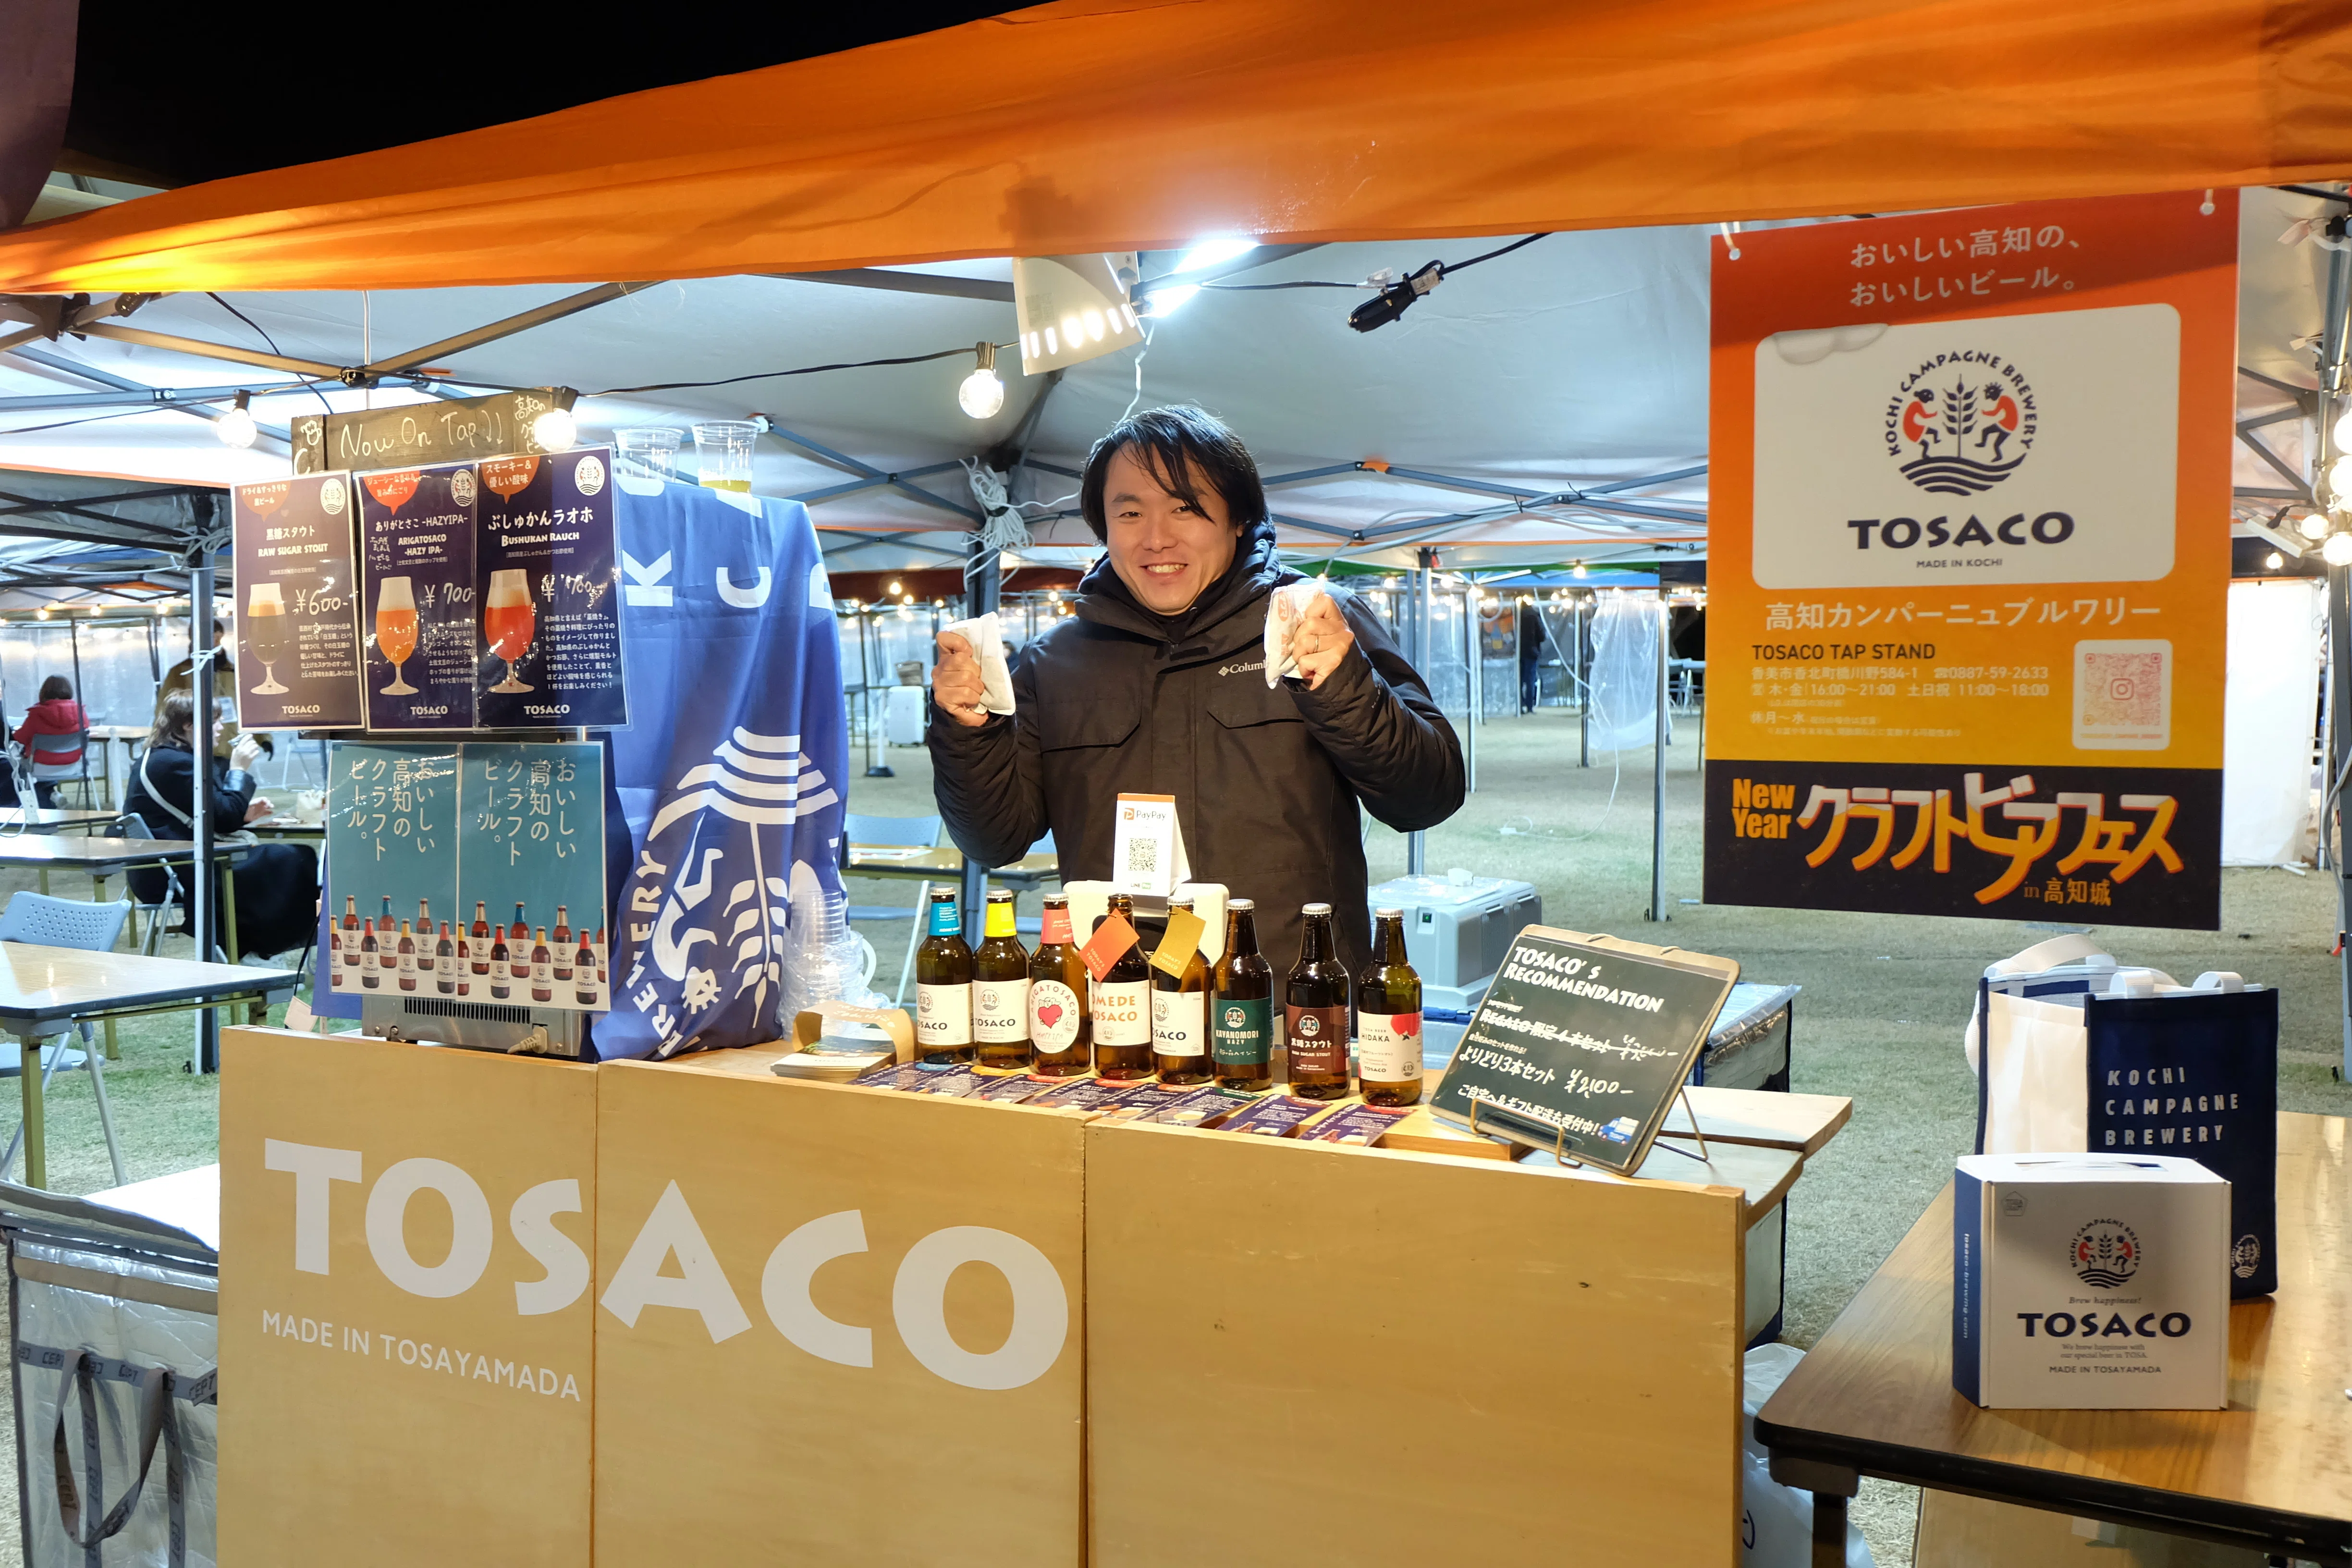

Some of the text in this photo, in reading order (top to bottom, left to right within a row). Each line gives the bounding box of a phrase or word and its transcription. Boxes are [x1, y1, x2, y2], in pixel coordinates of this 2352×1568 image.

[1850, 224, 2082, 269] おいしい高知の、
[1850, 266, 2076, 307] おいしいビール。
[1886, 350, 2037, 456] KOCHI CAMPAGNE BREWERY
[340, 411, 478, 458] Now On Tap
[486, 460, 532, 474] スモーキー&
[489, 473, 529, 488] 優しい酸味
[375, 518, 419, 532] ありがとさこ
[488, 506, 593, 530] ぶしゅかんラオホ
[266, 525, 315, 541] 黒糖スタウト
[398, 534, 447, 546] ARIGATOSACO
[1847, 511, 2075, 550] TOSACO
[258, 543, 329, 557] RAW SUGAR STOUT
[1916, 557, 2003, 569] MADE IN KOCHI
[1766, 597, 2161, 630] 高知カンパーニュブルワリー
[1752, 643, 1936, 660] TOSACO TAP STAND
[1229, 659, 1267, 674] Colum
[282, 704, 320, 714] TOSACO
[410, 705, 448, 715] TOSACO
[524, 704, 570, 715] TOSACO
[347, 759, 368, 840] ビール。
[392, 757, 412, 838] 高知の
[480, 759, 502, 843] ビール。
[528, 759, 551, 841] 高知の
[1733, 778, 1796, 809] New
[371, 759, 387, 861] クラフト
[416, 759, 435, 854] おいしい
[506, 760, 523, 866] クラフト
[556, 757, 576, 858] おいしい
[1136, 810, 1166, 821] PayPay
[1732, 807, 1792, 840] Year
[2023, 877, 2112, 907] in 高知城
[1502, 962, 1665, 1014] RECOMMENDATION
[918, 1021, 948, 1030] OSACO
[975, 1017, 1016, 1028] TOSACO
[1093, 1011, 1138, 1022] OSACO
[1215, 1029, 1259, 1039] KAYANOMORI
[1291, 1037, 1332, 1049] 黒糖スタウト
[1361, 1033, 1390, 1042] HIDAKA
[1459, 1045, 1556, 1086] よりどり3本セット
[2107, 1066, 2186, 1086] KOCHI
[2105, 1093, 2239, 1115] CAMPAGNE
[2105, 1125, 2224, 1146] BREWERY
[264, 1138, 1069, 1390] TOSACO
[2017, 1312, 2192, 1337] TOSACO
[261, 1309, 581, 1402] MADE IN TOSAYAMADA
[2049, 1366, 2162, 1374] MADE IN TOSAYAMADA
